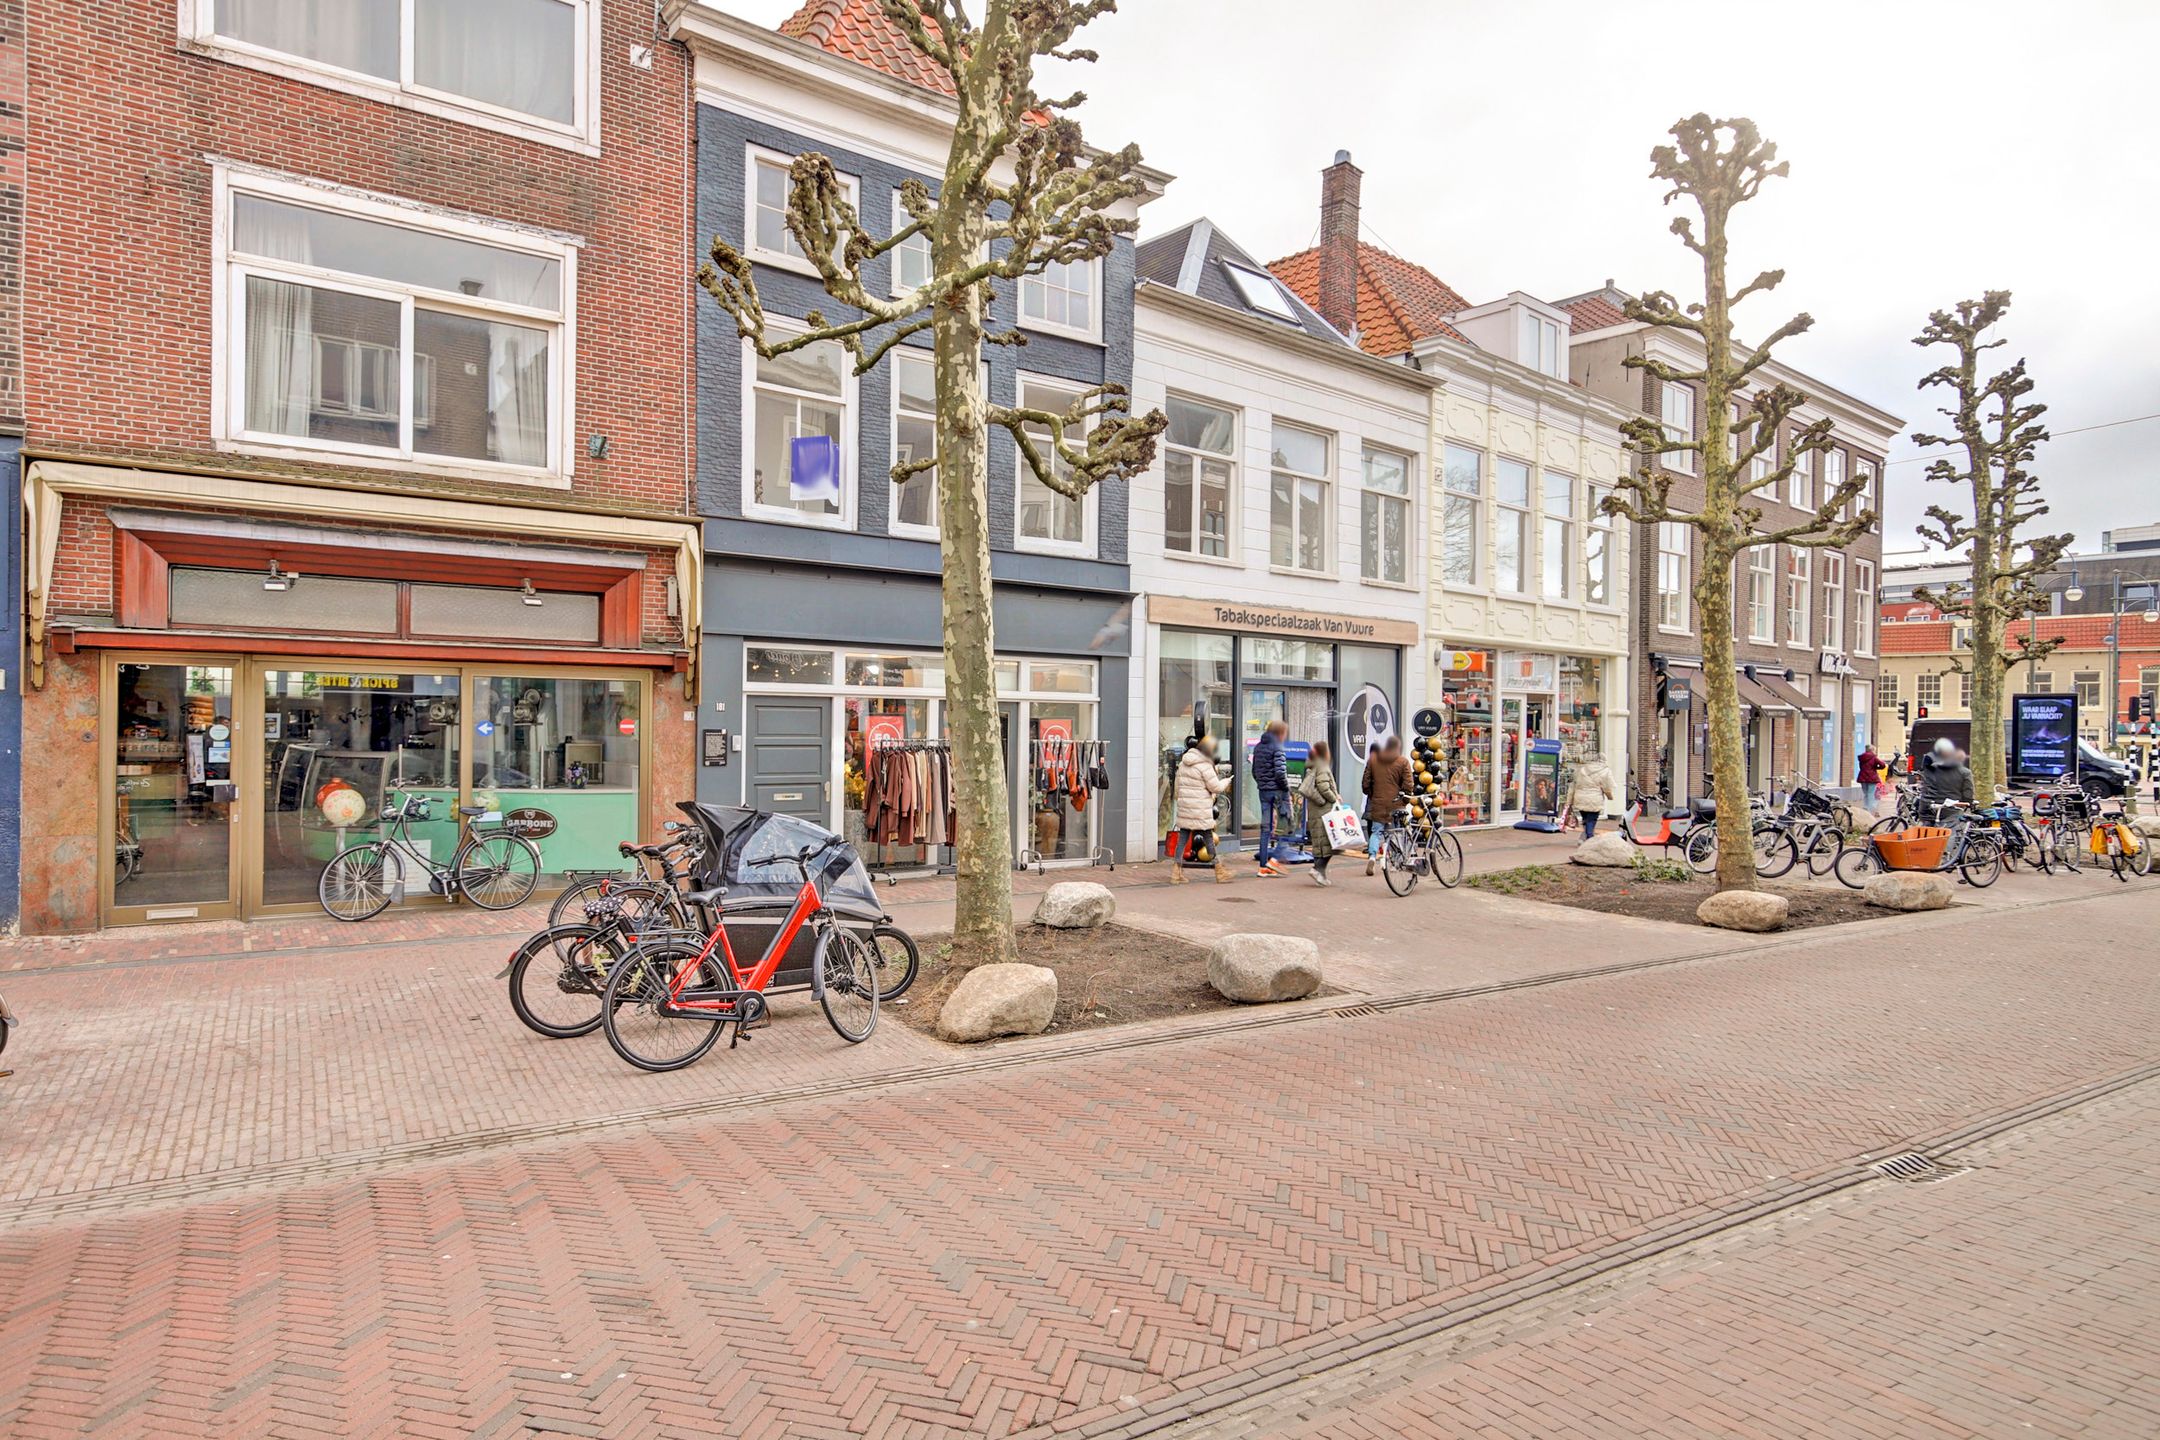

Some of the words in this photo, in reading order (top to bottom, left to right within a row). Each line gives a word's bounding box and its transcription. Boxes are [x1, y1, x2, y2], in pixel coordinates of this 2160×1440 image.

[1214, 607, 1322, 631] Tabakspeciaalzaak
[1323, 618, 1343, 633] Van
[1345, 620, 1375, 636] Vuure
[716, 702, 726, 711] 181
[1352, 734, 1365, 744] VAN
